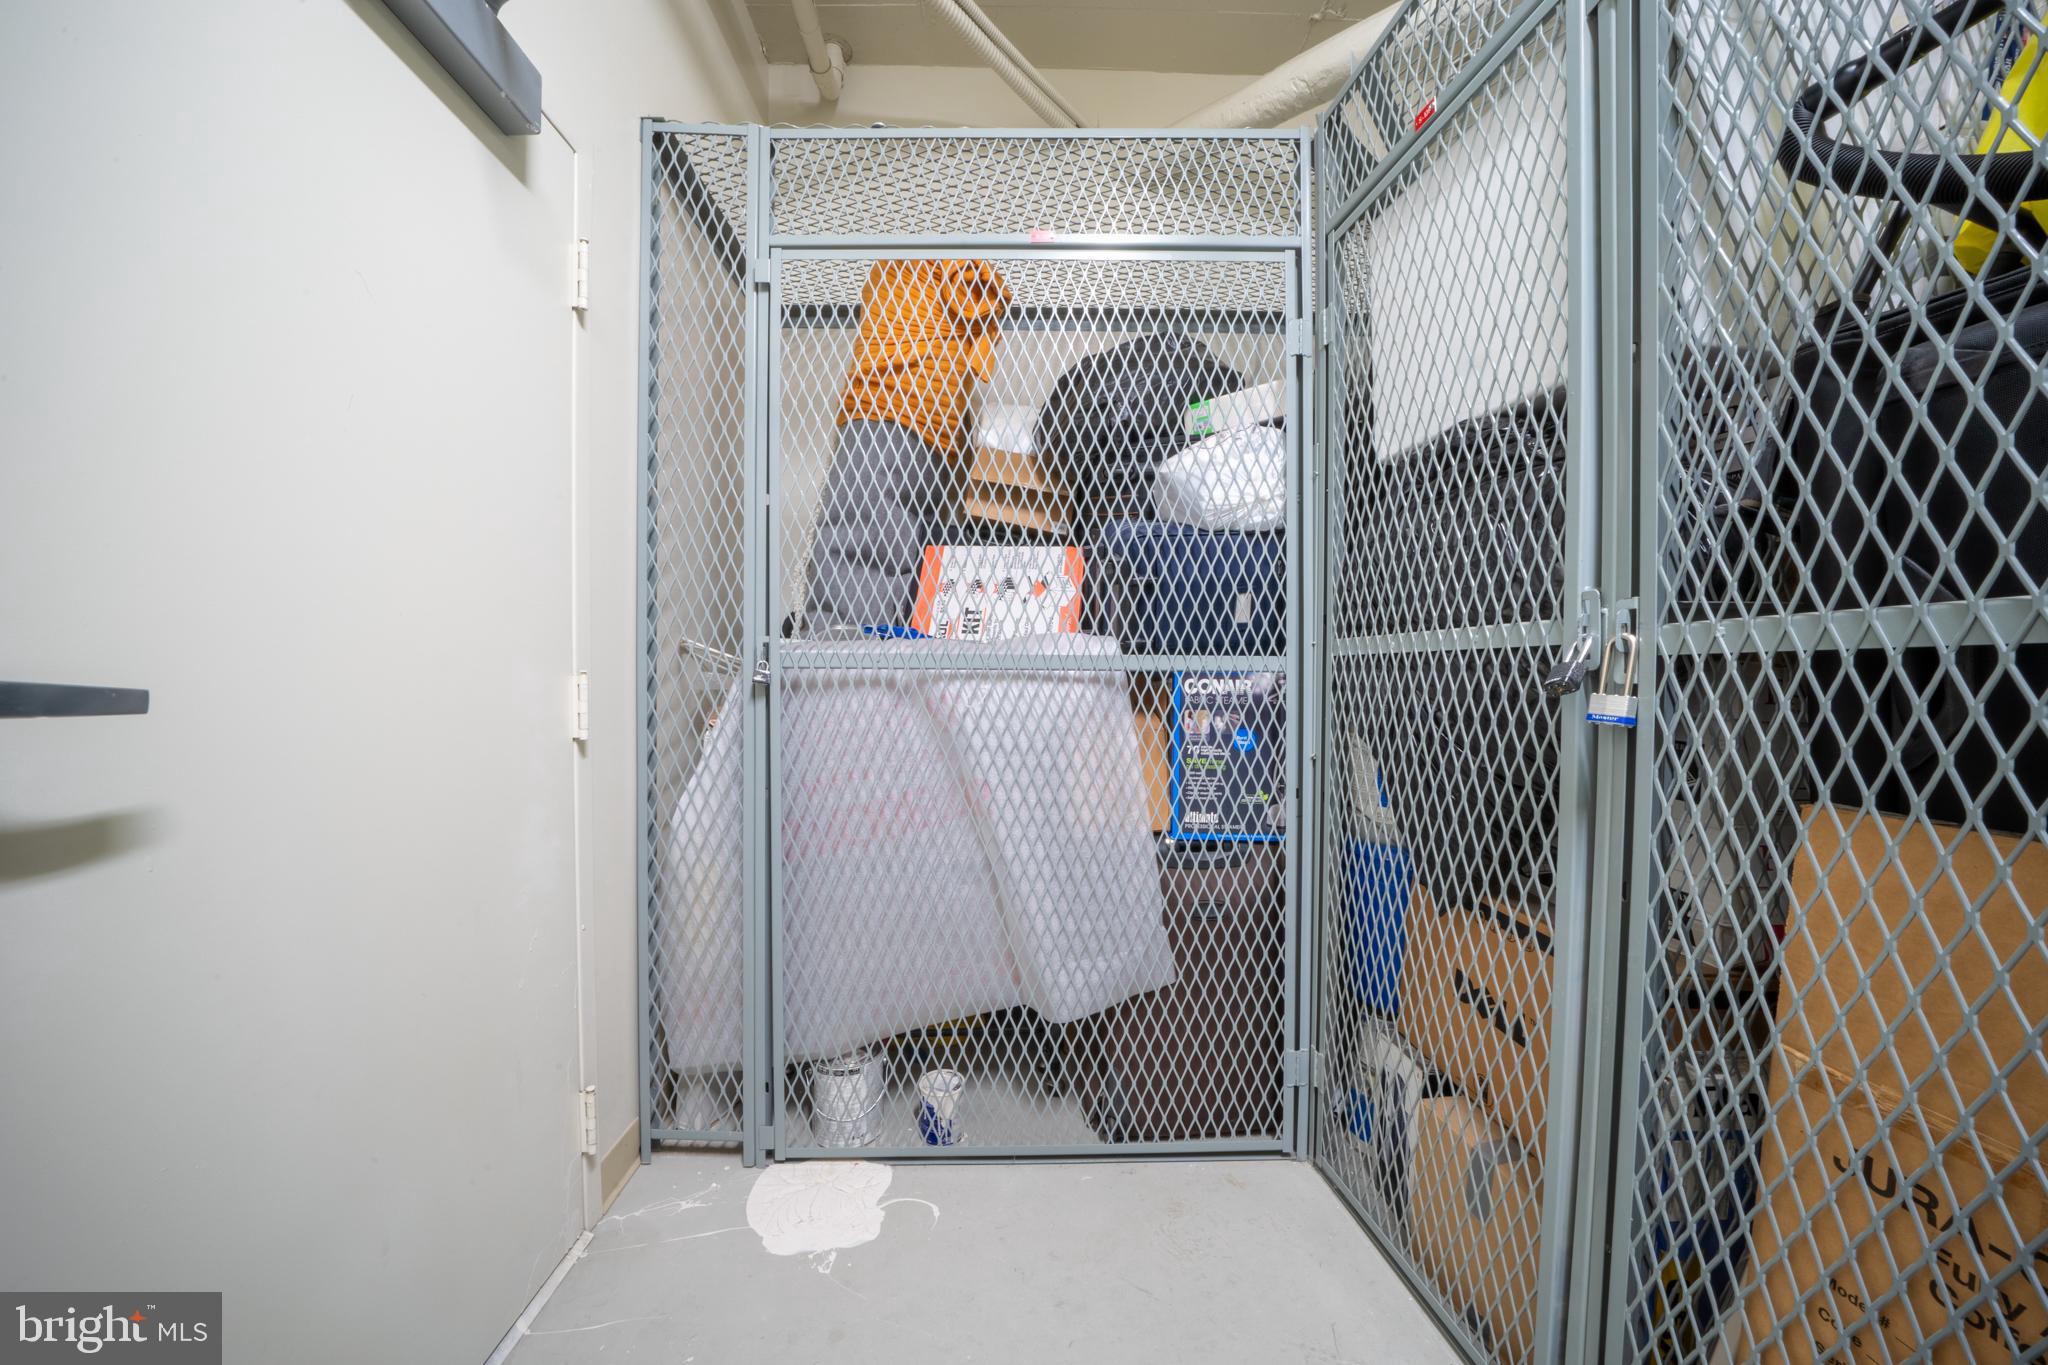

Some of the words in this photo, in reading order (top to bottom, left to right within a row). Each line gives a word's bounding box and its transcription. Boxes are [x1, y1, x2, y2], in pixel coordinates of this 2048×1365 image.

[962, 607, 983, 635] KIT
[1184, 678, 1253, 695] CONAIR
[1591, 714, 1619, 722] Master
[1827, 1278, 1872, 1314] Mode
[1936, 1248, 2027, 1322] Fuy
